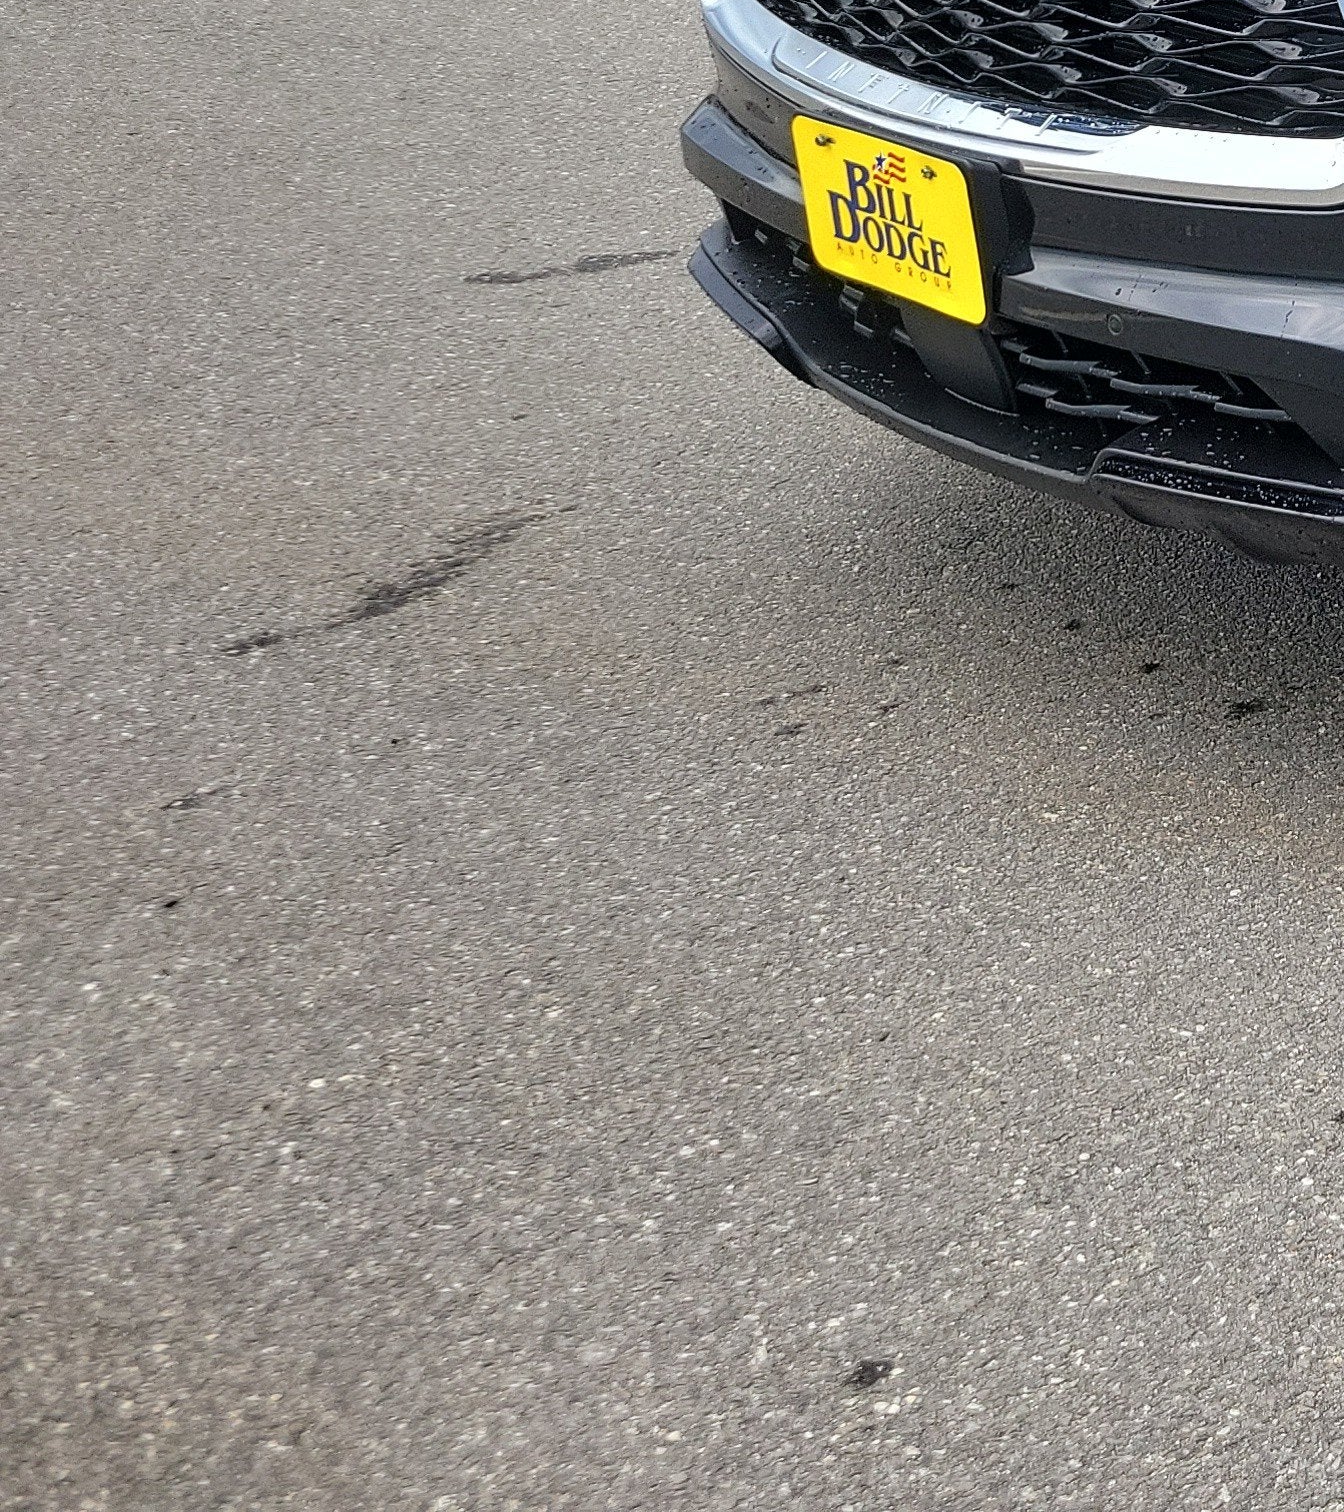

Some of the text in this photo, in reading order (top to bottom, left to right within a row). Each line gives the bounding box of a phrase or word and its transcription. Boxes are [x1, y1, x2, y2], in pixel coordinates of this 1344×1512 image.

[842, 158, 924, 233] BILL
[826, 189, 953, 279] DODGE
[836, 242, 879, 265] AUTO
